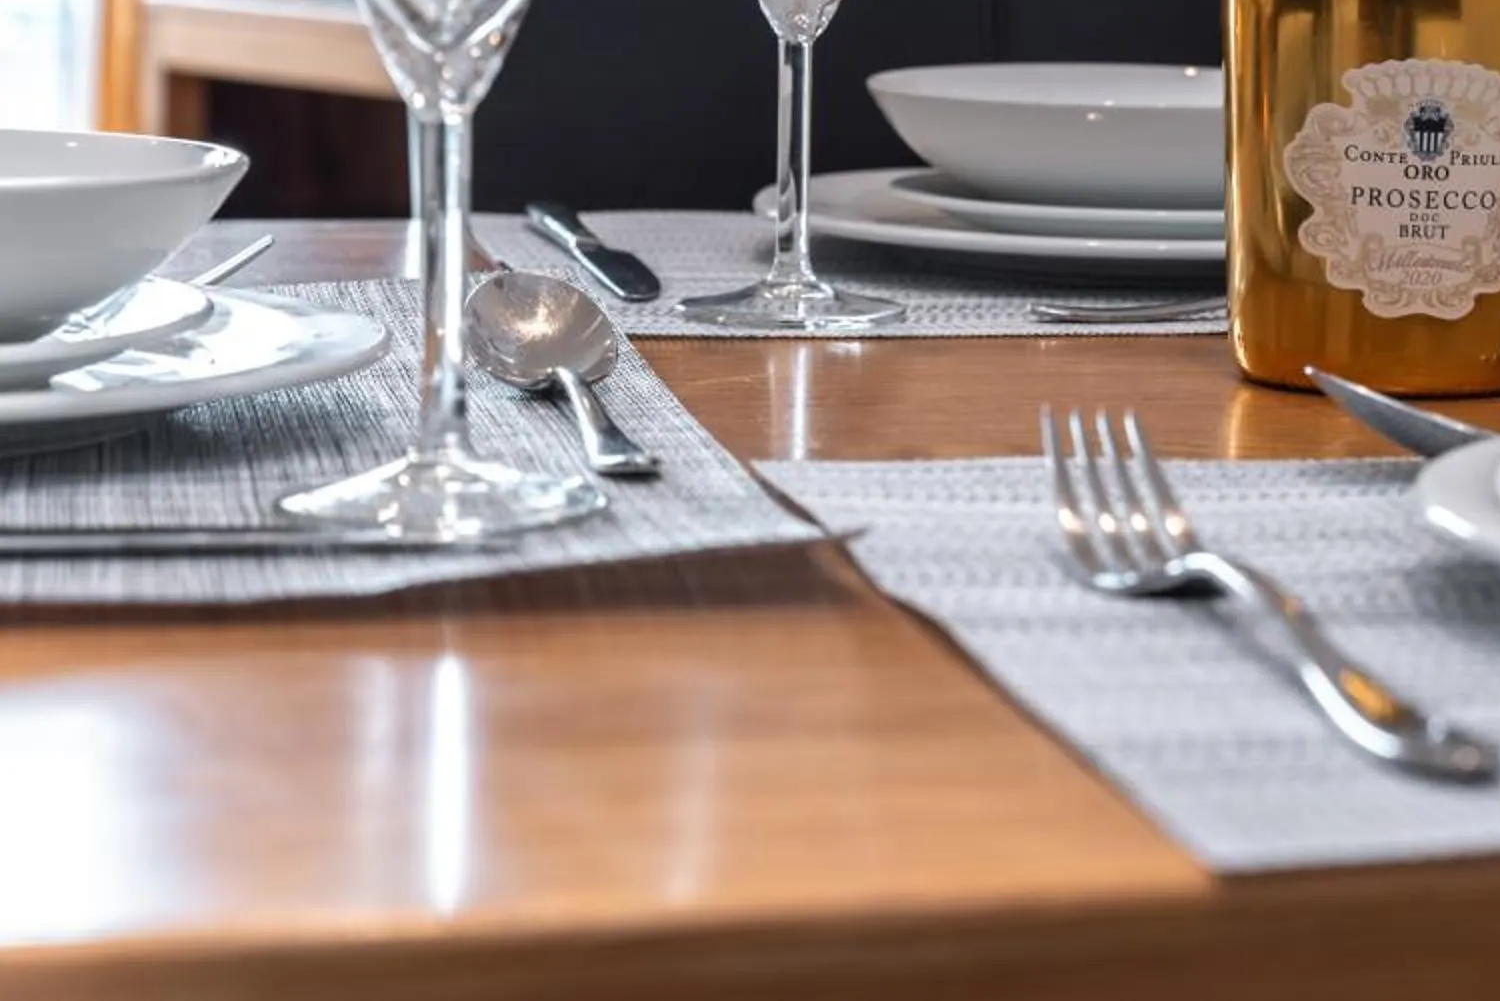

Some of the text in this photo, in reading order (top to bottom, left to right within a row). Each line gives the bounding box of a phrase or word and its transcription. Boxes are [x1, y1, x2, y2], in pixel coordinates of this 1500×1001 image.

[1344, 144, 1408, 164] CONTE
[1403, 164, 1450, 181] ORO
[1351, 186, 1497, 210] PROSECCO
[1409, 212, 1440, 222] DOC
[1399, 224, 1450, 240] BRUT
